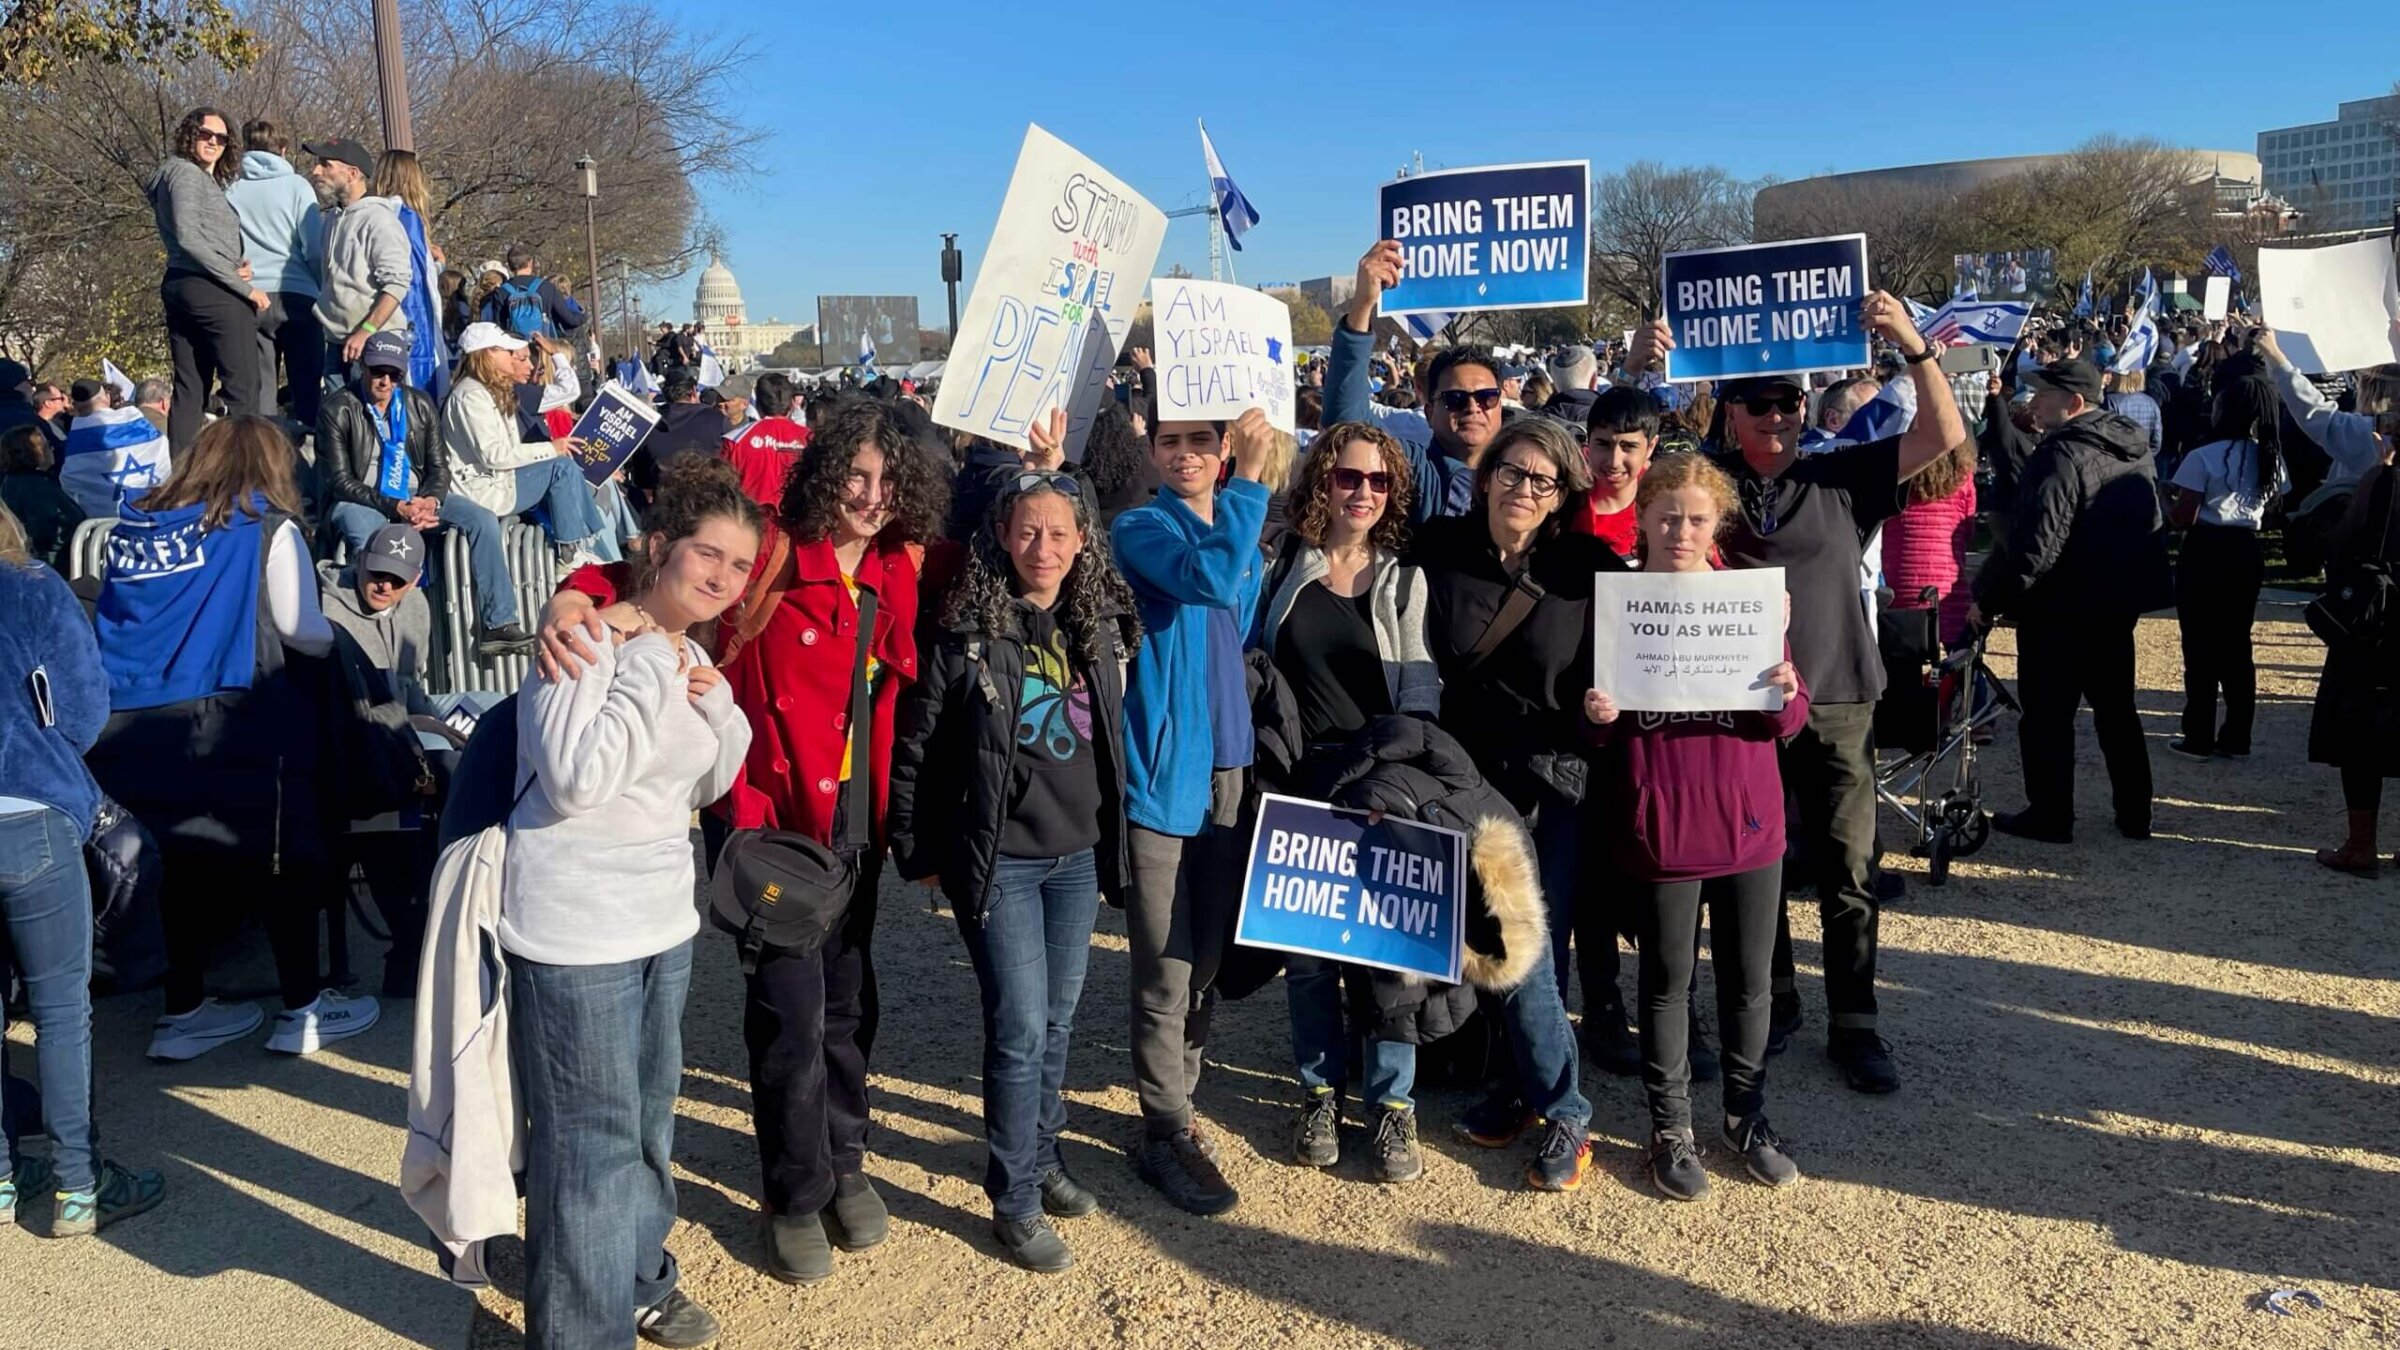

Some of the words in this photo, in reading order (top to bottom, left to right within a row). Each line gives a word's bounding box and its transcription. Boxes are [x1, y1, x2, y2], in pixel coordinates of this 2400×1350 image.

[1052, 173, 1139, 255] STAND
[1393, 200, 1482, 238] BRING
[1492, 194, 1573, 232] THEM
[1073, 241, 1098, 267] with
[1399, 242, 1480, 279] HOME
[1491, 237, 1568, 274] NOW!
[1041, 257, 1114, 312] ISRAEL
[1678, 274, 1763, 312] BRING
[1772, 265, 1851, 303] THEM
[1061, 303, 1083, 323] FOR
[1166, 286, 1225, 321] AM
[1167, 327, 1259, 358] YISRAEL
[1683, 313, 1762, 349] HOME
[1772, 305, 1847, 342] NOW!
[599, 406, 638, 440] YISRAEL
[615, 406, 634, 422] AM
[599, 421, 625, 442] CHAI
[1626, 600, 1695, 614] HAMAS
[1702, 601, 1763, 614] HATES
[1630, 623, 1670, 636] YOU
[1676, 625, 1701, 637] AS
[1708, 624, 1758, 636] WELL
[1636, 652, 1670, 661] AHMAD
[1672, 653, 1691, 662] ABU
[1267, 829, 1358, 877] BRING
[1370, 845, 1443, 895] THEM
[1263, 873, 1350, 920] HOME
[1357, 889, 1437, 939] NOW!
[323, 1010, 351, 1021] HOKA
